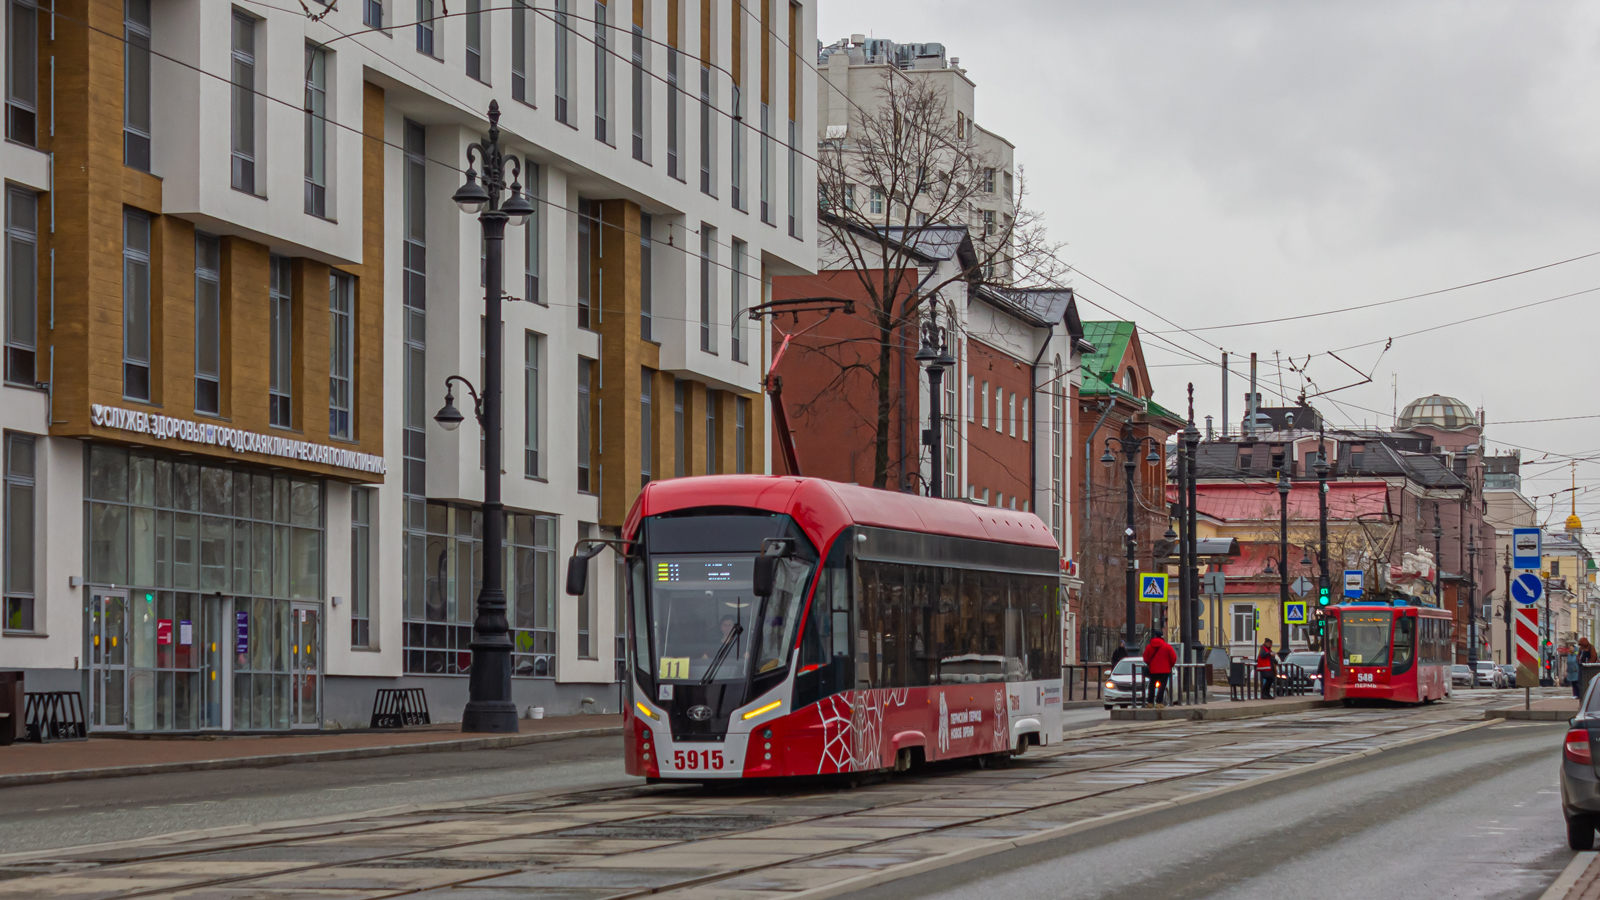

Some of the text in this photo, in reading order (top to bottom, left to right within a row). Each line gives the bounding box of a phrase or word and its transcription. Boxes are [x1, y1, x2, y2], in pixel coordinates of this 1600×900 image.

[103, 406, 387, 475] СЛУЖБА ЗДОРОВЬЯ ГОРОДСКАЯ КЛИНИЧЕСКАЯ ПОЛИКЛИНИКА
[664, 661, 681, 679] 11
[1357, 674, 1373, 682] 548
[674, 749, 724, 770] 5915
